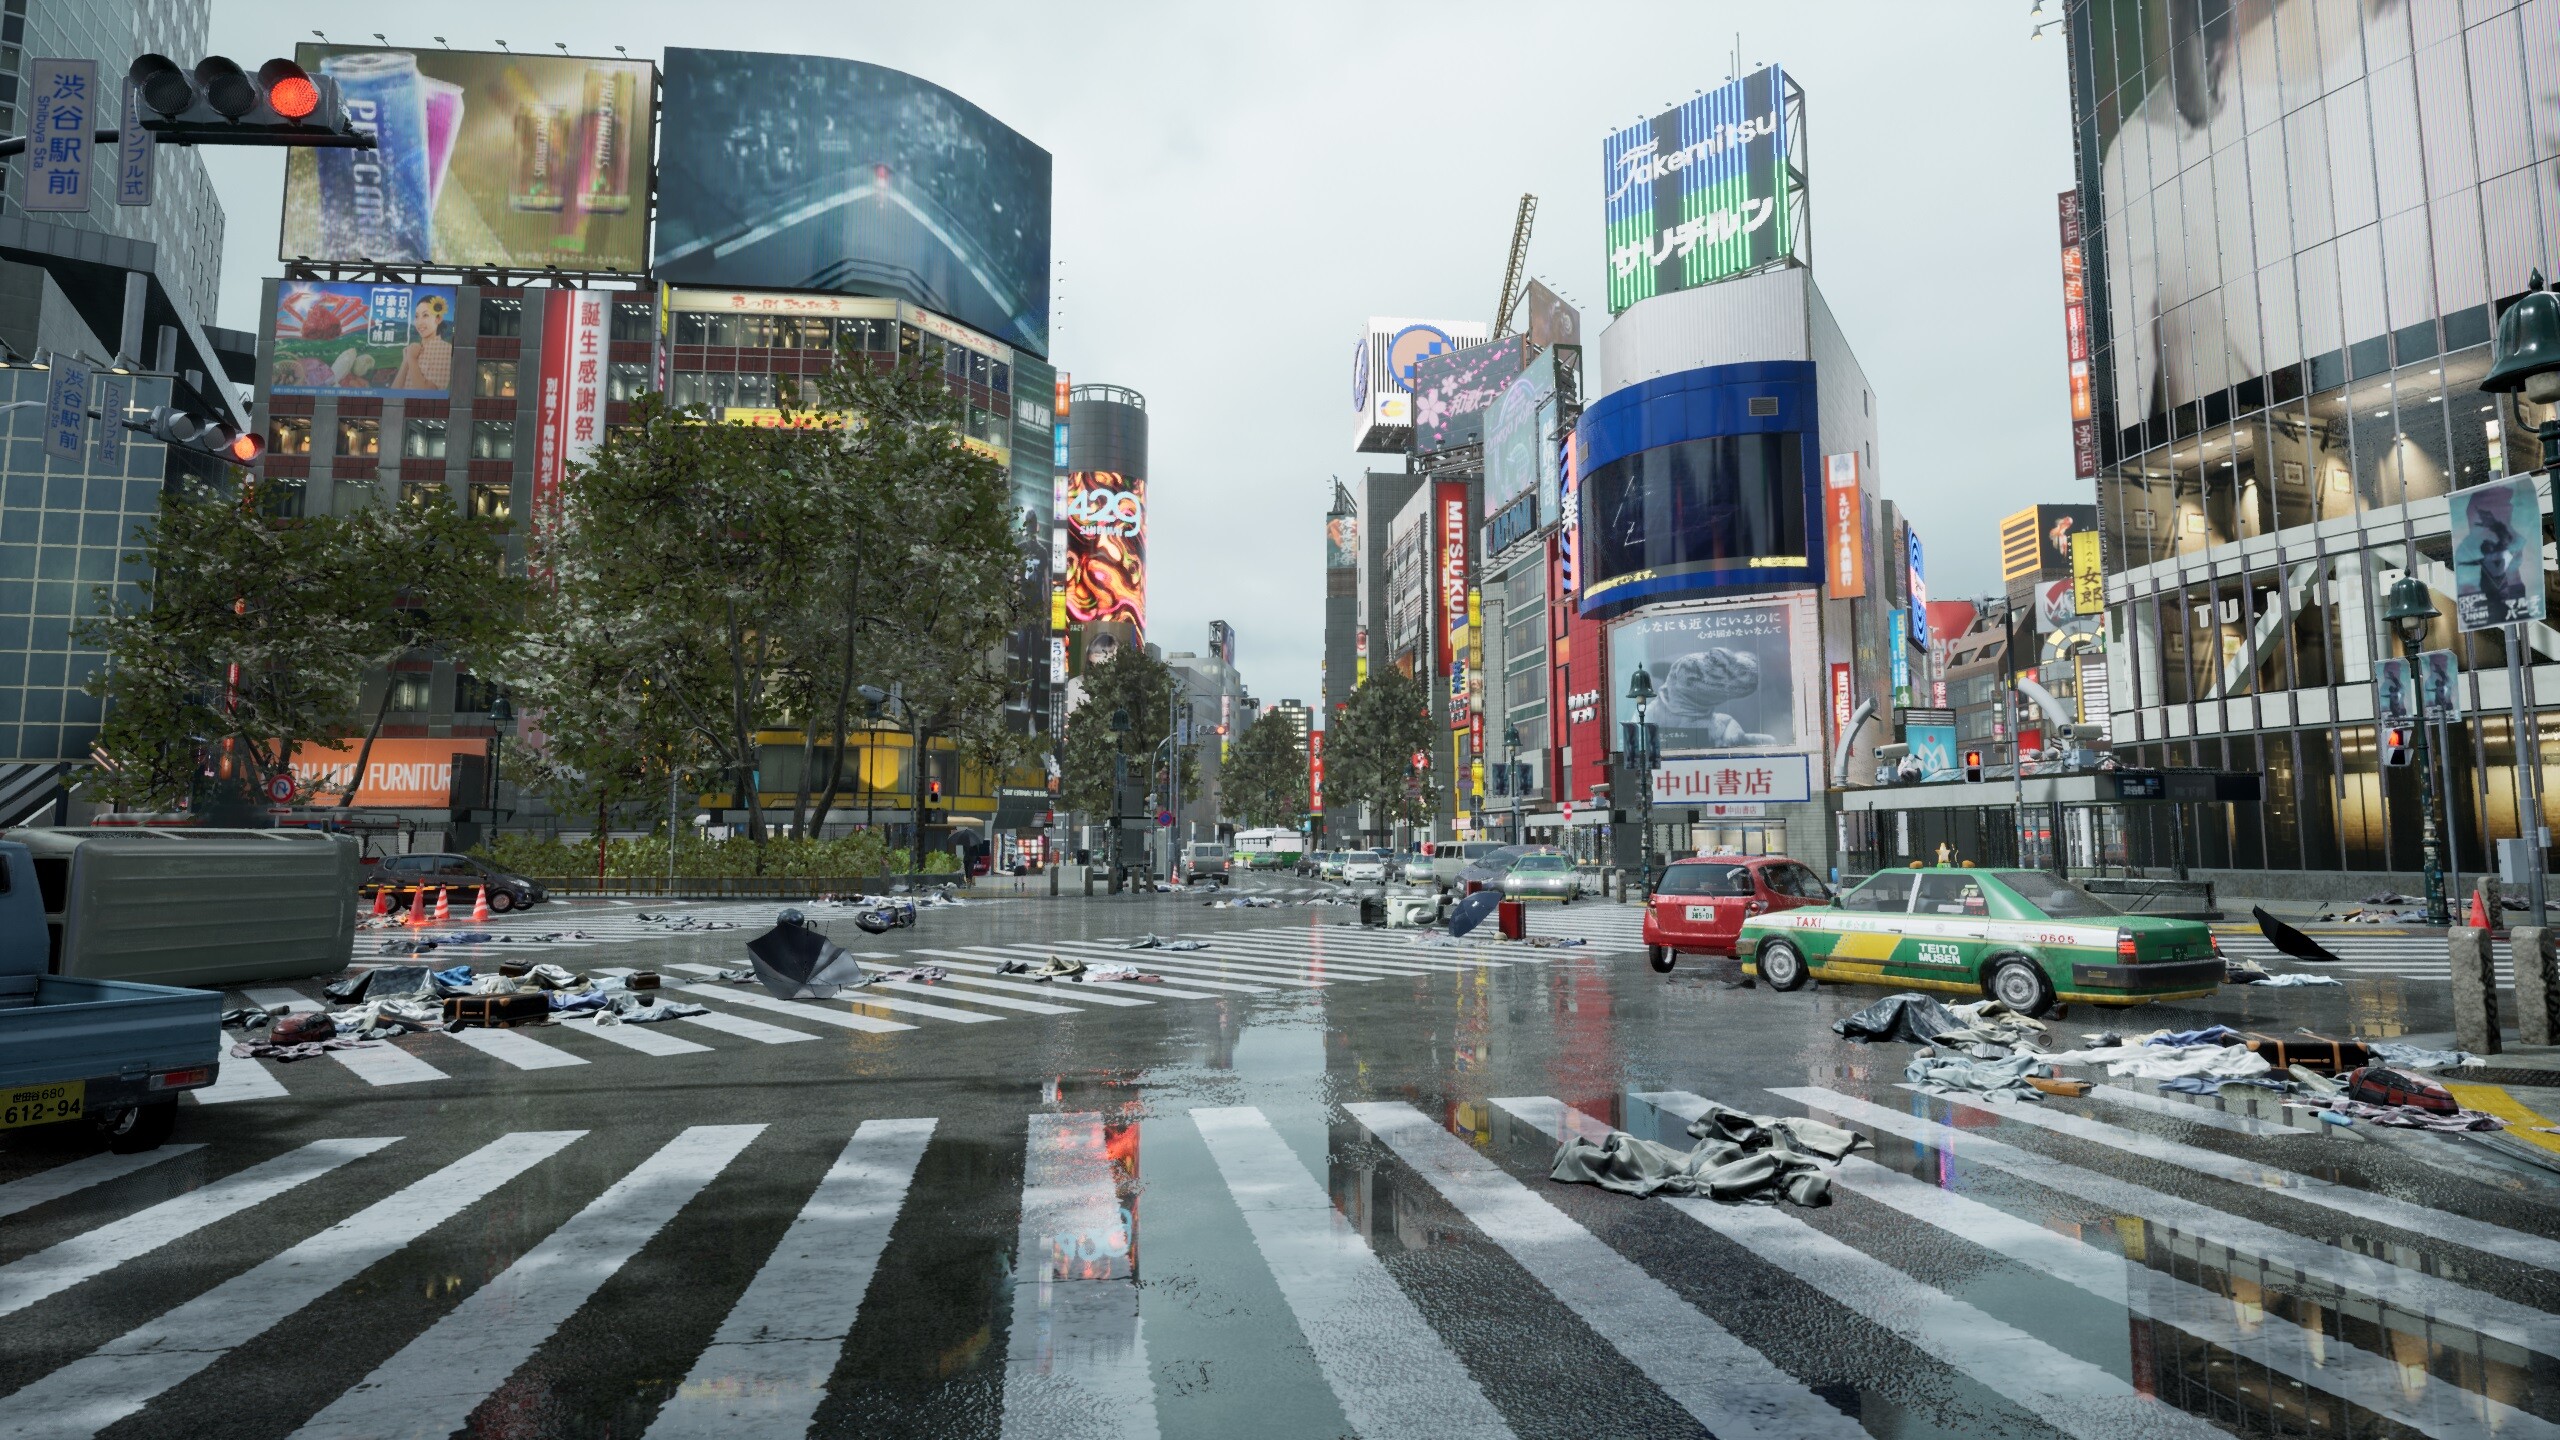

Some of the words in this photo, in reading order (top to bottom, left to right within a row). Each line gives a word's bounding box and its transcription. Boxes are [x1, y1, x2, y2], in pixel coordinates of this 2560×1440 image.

[33, 95, 50, 144] Shibuya
[48, 74, 85, 194] 渋谷駅前
[124, 94, 146, 195] ランブル式
[1605, 111, 1777, 202] Takemitsu
[575, 302, 600, 441] 誕生感謝祭
[59, 368, 84, 450] 渋谷駅前
[104, 388, 119, 460] スクランブル式
[1068, 488, 1141, 537] 429
[1449, 501, 1464, 645] MITSUKU
[2079, 566, 2103, 606] 女郎
[2464, 610, 2489, 622] Japan
[2504, 595, 2541, 609] マルチ
[1636, 612, 1781, 635] こんなにも近くにいるのに
[1697, 625, 1782, 640] 心が届かないなんて
[1656, 768, 1773, 796] 中山書店
[1796, 916, 1822, 928] TAXI
[1919, 943, 1959, 955] TEITO
[1919, 953, 1961, 965] MUSEN
[41, 1087, 65, 1100] 680
[5, 1098, 81, 1125] 612-94
